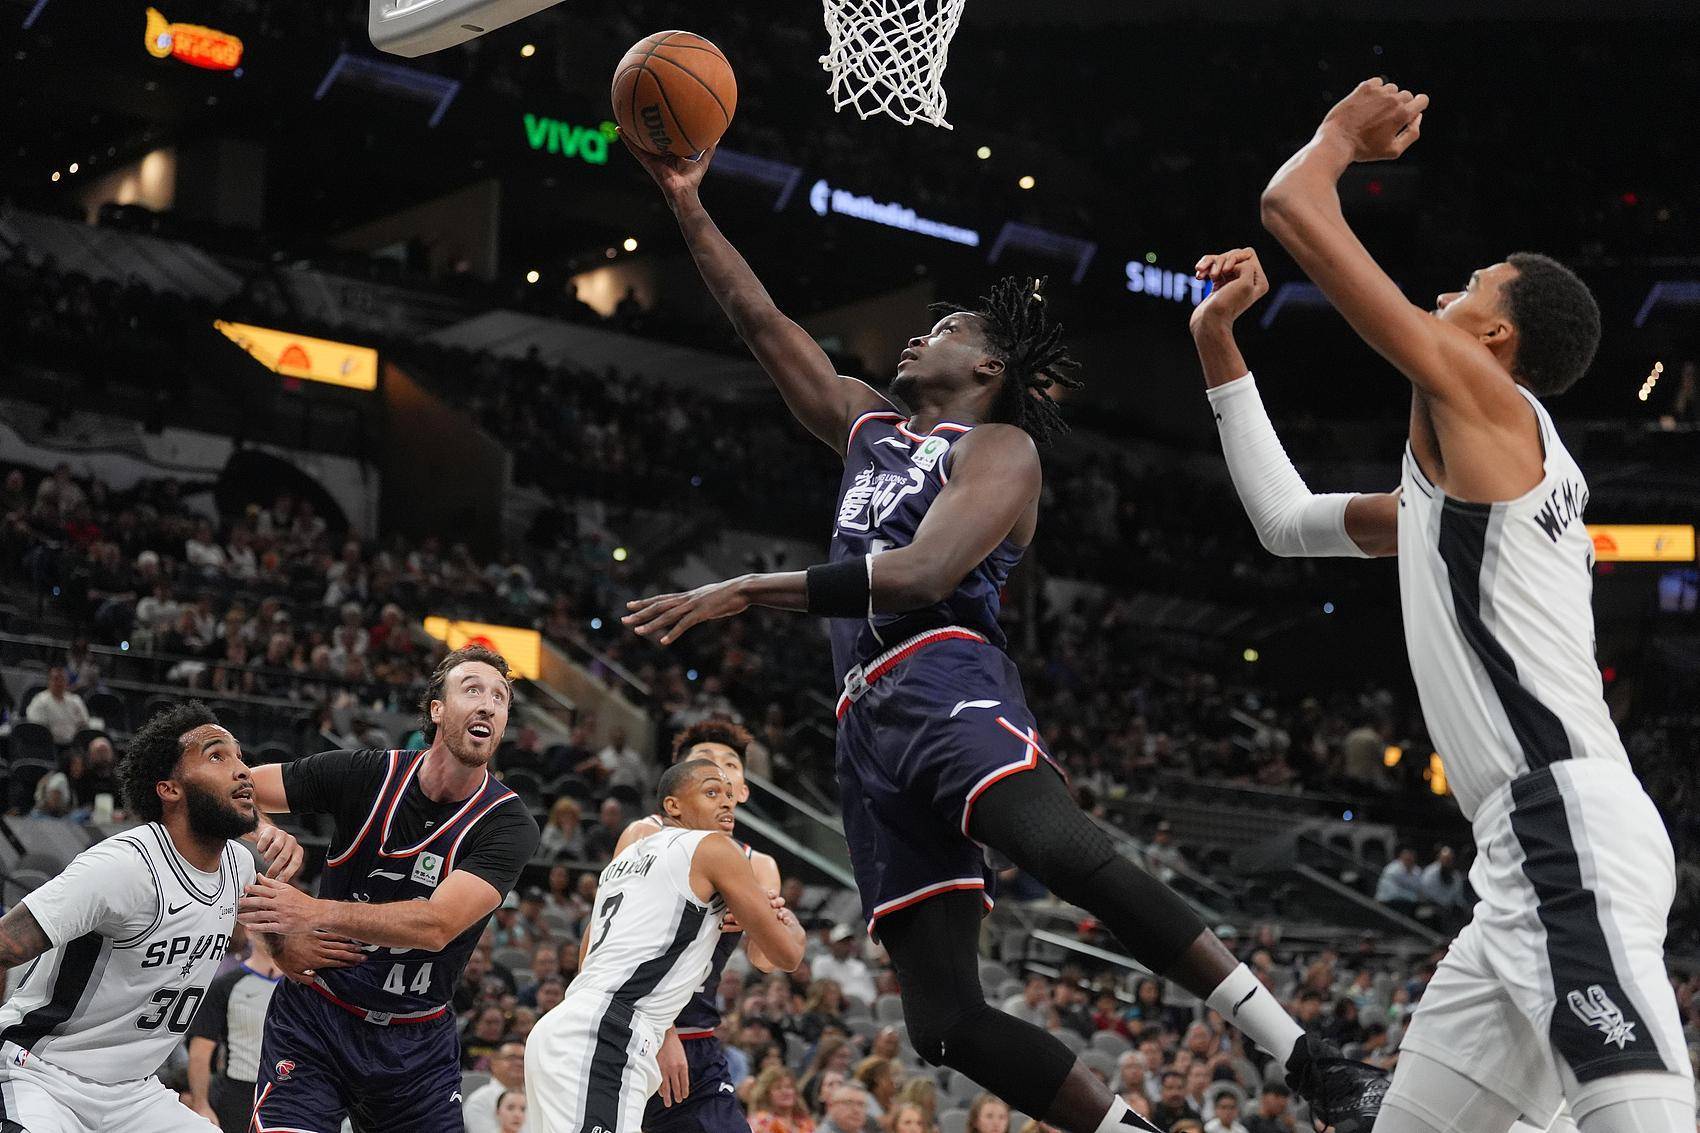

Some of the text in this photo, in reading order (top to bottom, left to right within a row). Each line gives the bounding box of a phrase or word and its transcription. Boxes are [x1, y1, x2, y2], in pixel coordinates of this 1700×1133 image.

[1533, 478, 1588, 543] WEM
[383, 963, 433, 995] 44
[136, 986, 205, 1034] 30
